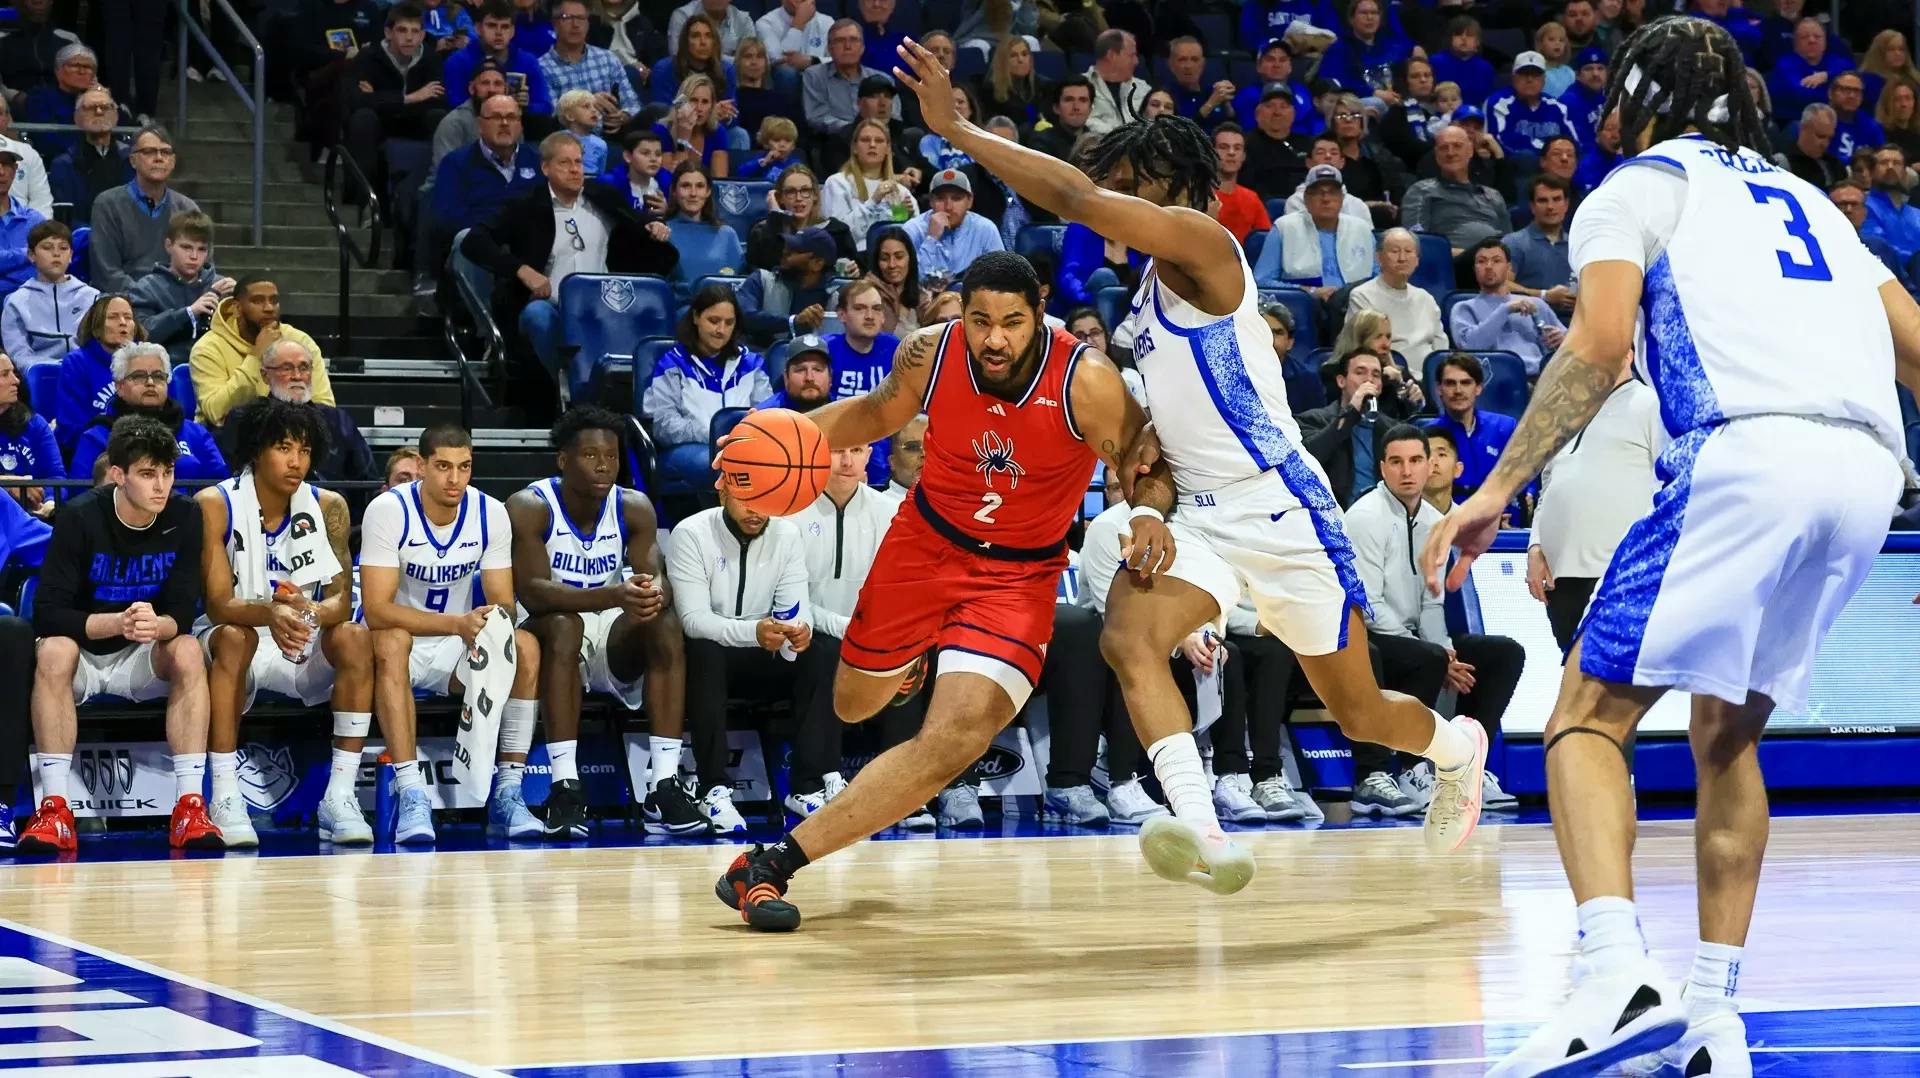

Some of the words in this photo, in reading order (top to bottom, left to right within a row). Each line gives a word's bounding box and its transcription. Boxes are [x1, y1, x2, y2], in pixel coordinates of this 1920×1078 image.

[1744, 180, 1833, 281] 3
[973, 492, 1003, 524] 2
[1195, 494, 1216, 507] SLU
[405, 560, 476, 584] BILLIKENS
[425, 588, 450, 613] 9
[1830, 725, 1897, 734] DAKTRONICS
[71, 799, 159, 810] BUICK
